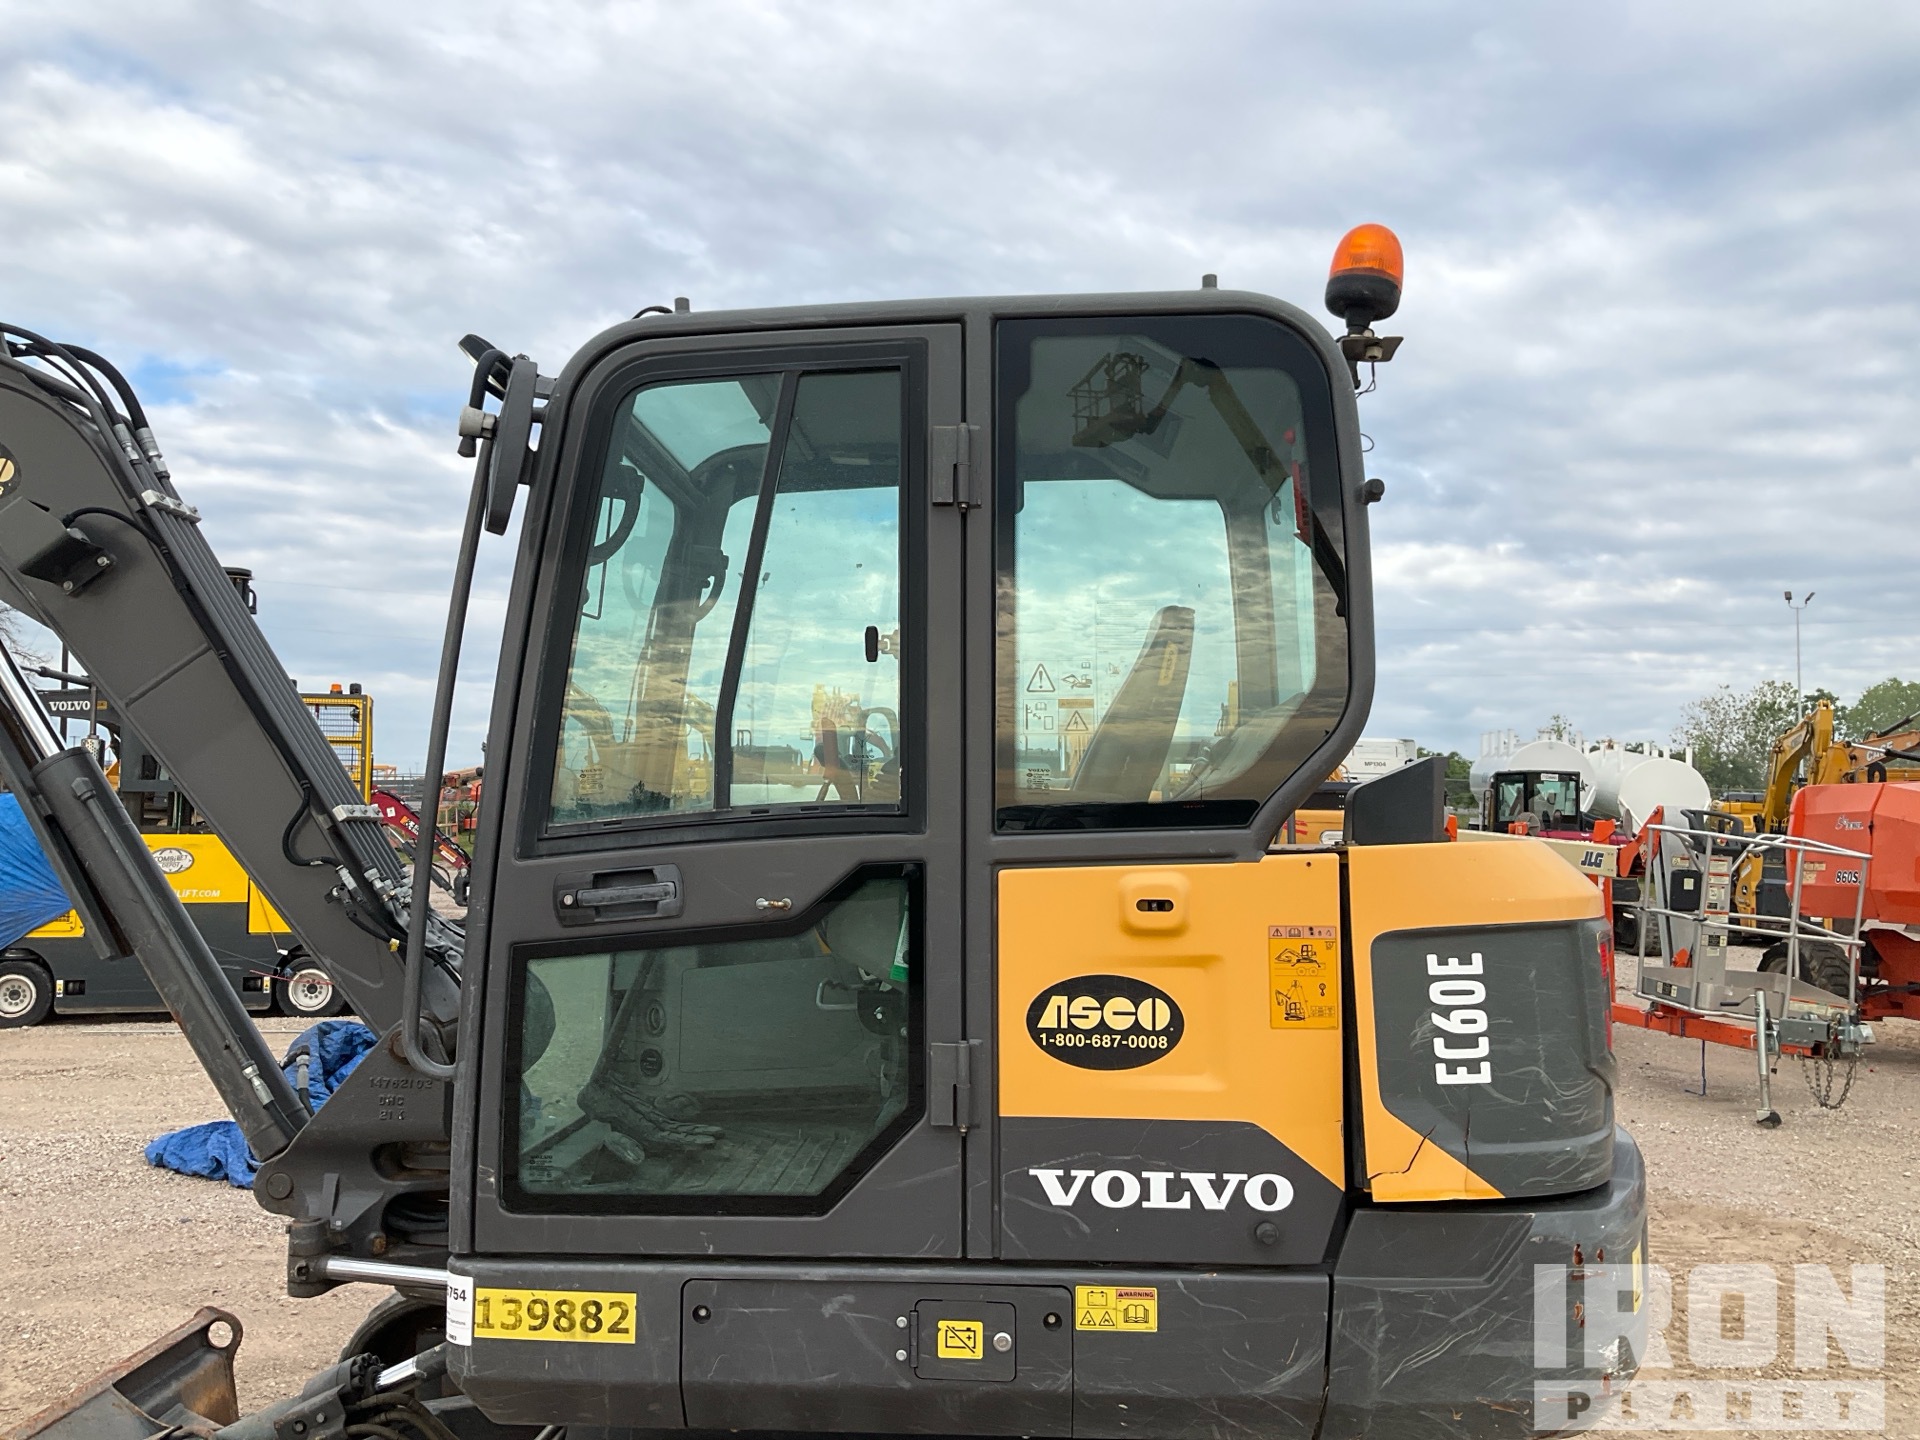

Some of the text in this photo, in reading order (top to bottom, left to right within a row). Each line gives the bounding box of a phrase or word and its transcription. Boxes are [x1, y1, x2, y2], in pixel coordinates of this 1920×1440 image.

[49, 701, 91, 711] VOLVO
[1580, 850, 1605, 868] JLG
[1835, 871, 1862, 884] 860S
[1037, 995, 1171, 1031] ASCO
[1427, 952, 1492, 1085] EC60E
[1039, 1033, 1168, 1049] 1-800-687-0008
[1029, 1169, 1294, 1212] VOLVO
[447, 1285, 467, 1302] 754
[476, 1297, 630, 1335] 139882
